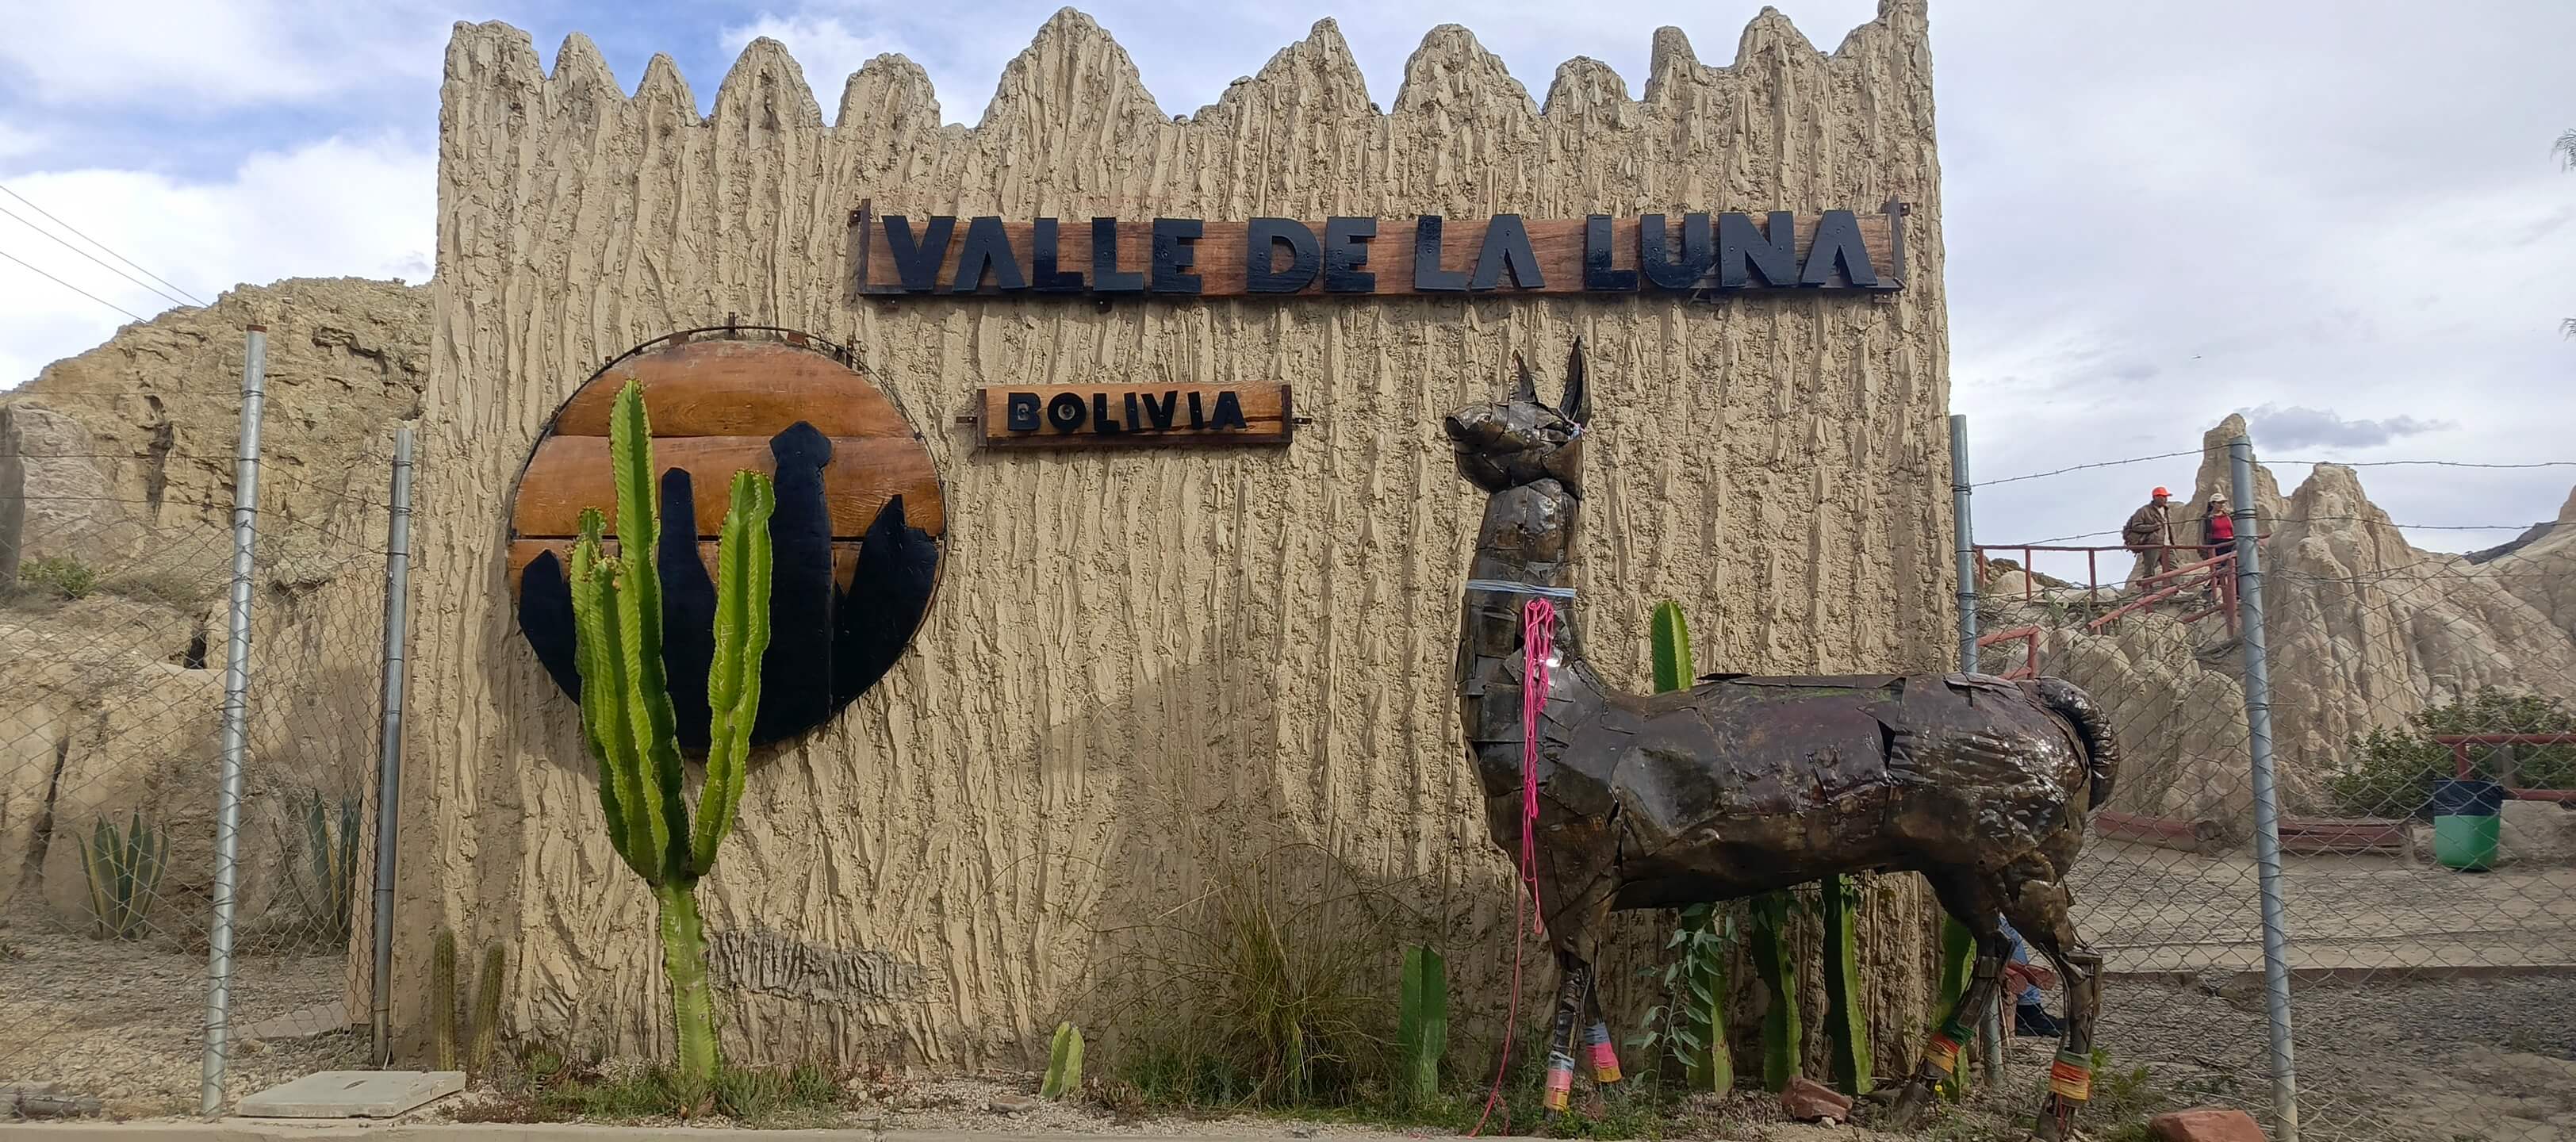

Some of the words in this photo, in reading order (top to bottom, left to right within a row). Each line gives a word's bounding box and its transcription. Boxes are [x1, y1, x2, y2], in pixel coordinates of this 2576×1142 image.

[881, 216, 1203, 293] VALLE
[1247, 216, 1377, 293] DE
[1414, 213, 1546, 290] LA
[1585, 209, 1878, 290] LUNA
[1007, 390, 1248, 432] BOLIVIA
